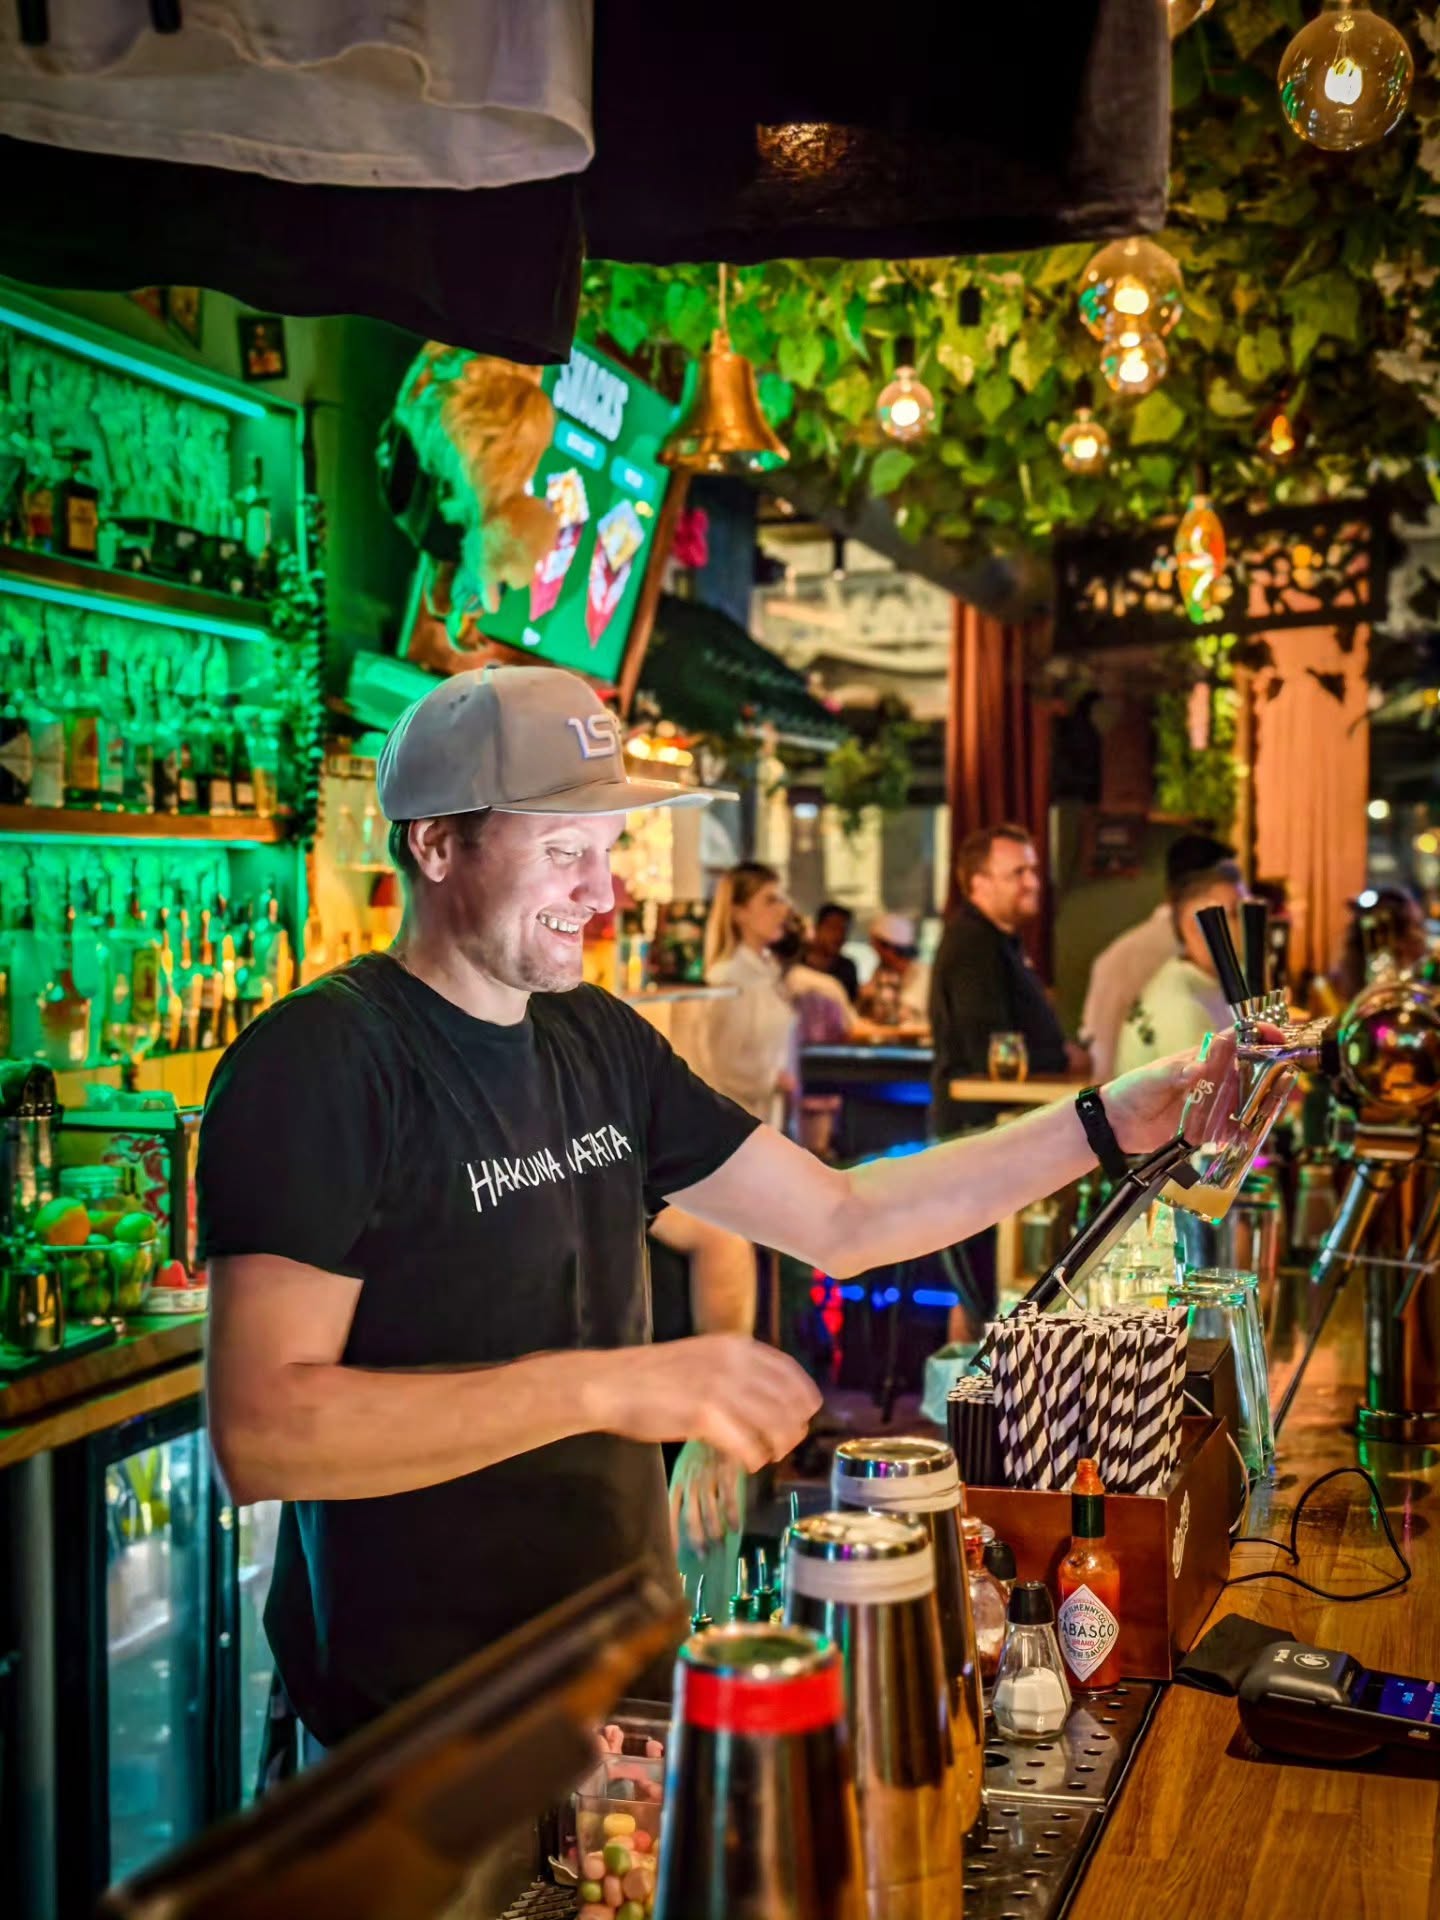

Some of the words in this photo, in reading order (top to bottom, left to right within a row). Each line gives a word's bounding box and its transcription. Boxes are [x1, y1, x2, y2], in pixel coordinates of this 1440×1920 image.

[467, 1148, 565, 1213] HAKUNA
[566, 1124, 632, 1174] AATA
[1060, 1620, 1115, 1639] ABASCO
